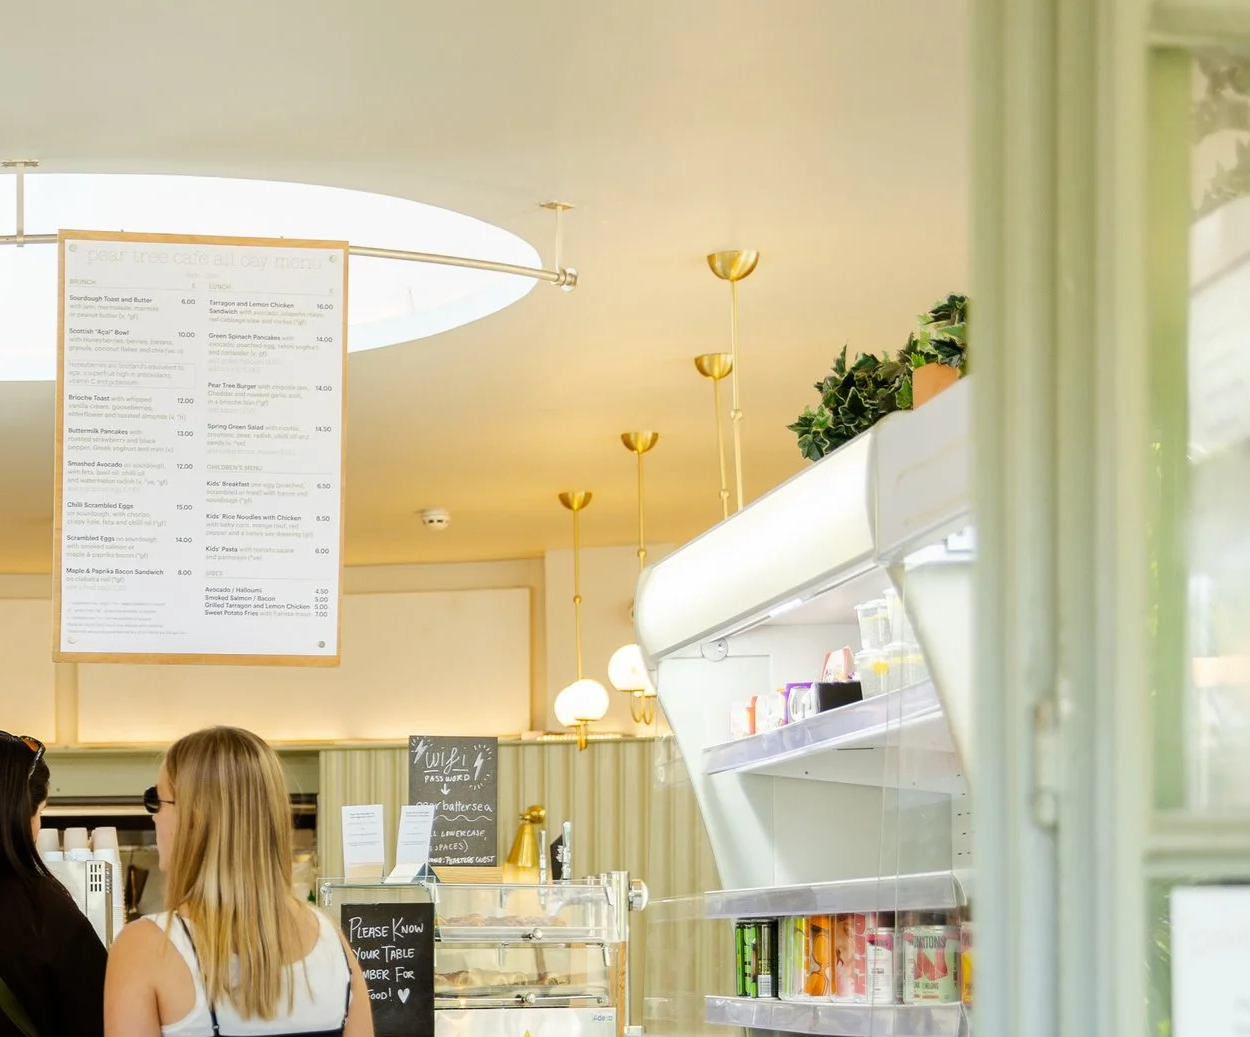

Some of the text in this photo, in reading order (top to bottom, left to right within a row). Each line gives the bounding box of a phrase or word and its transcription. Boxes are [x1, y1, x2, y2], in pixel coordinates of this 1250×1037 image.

[69, 295, 103, 303] Sourdough
[228, 333, 252, 341] Spinach
[424, 774, 470, 784] PASSWORD
[349, 916, 424, 943] PLEASE KNOW
[381, 945, 415, 963] TABLE
[363, 966, 416, 983] MBER FOR
